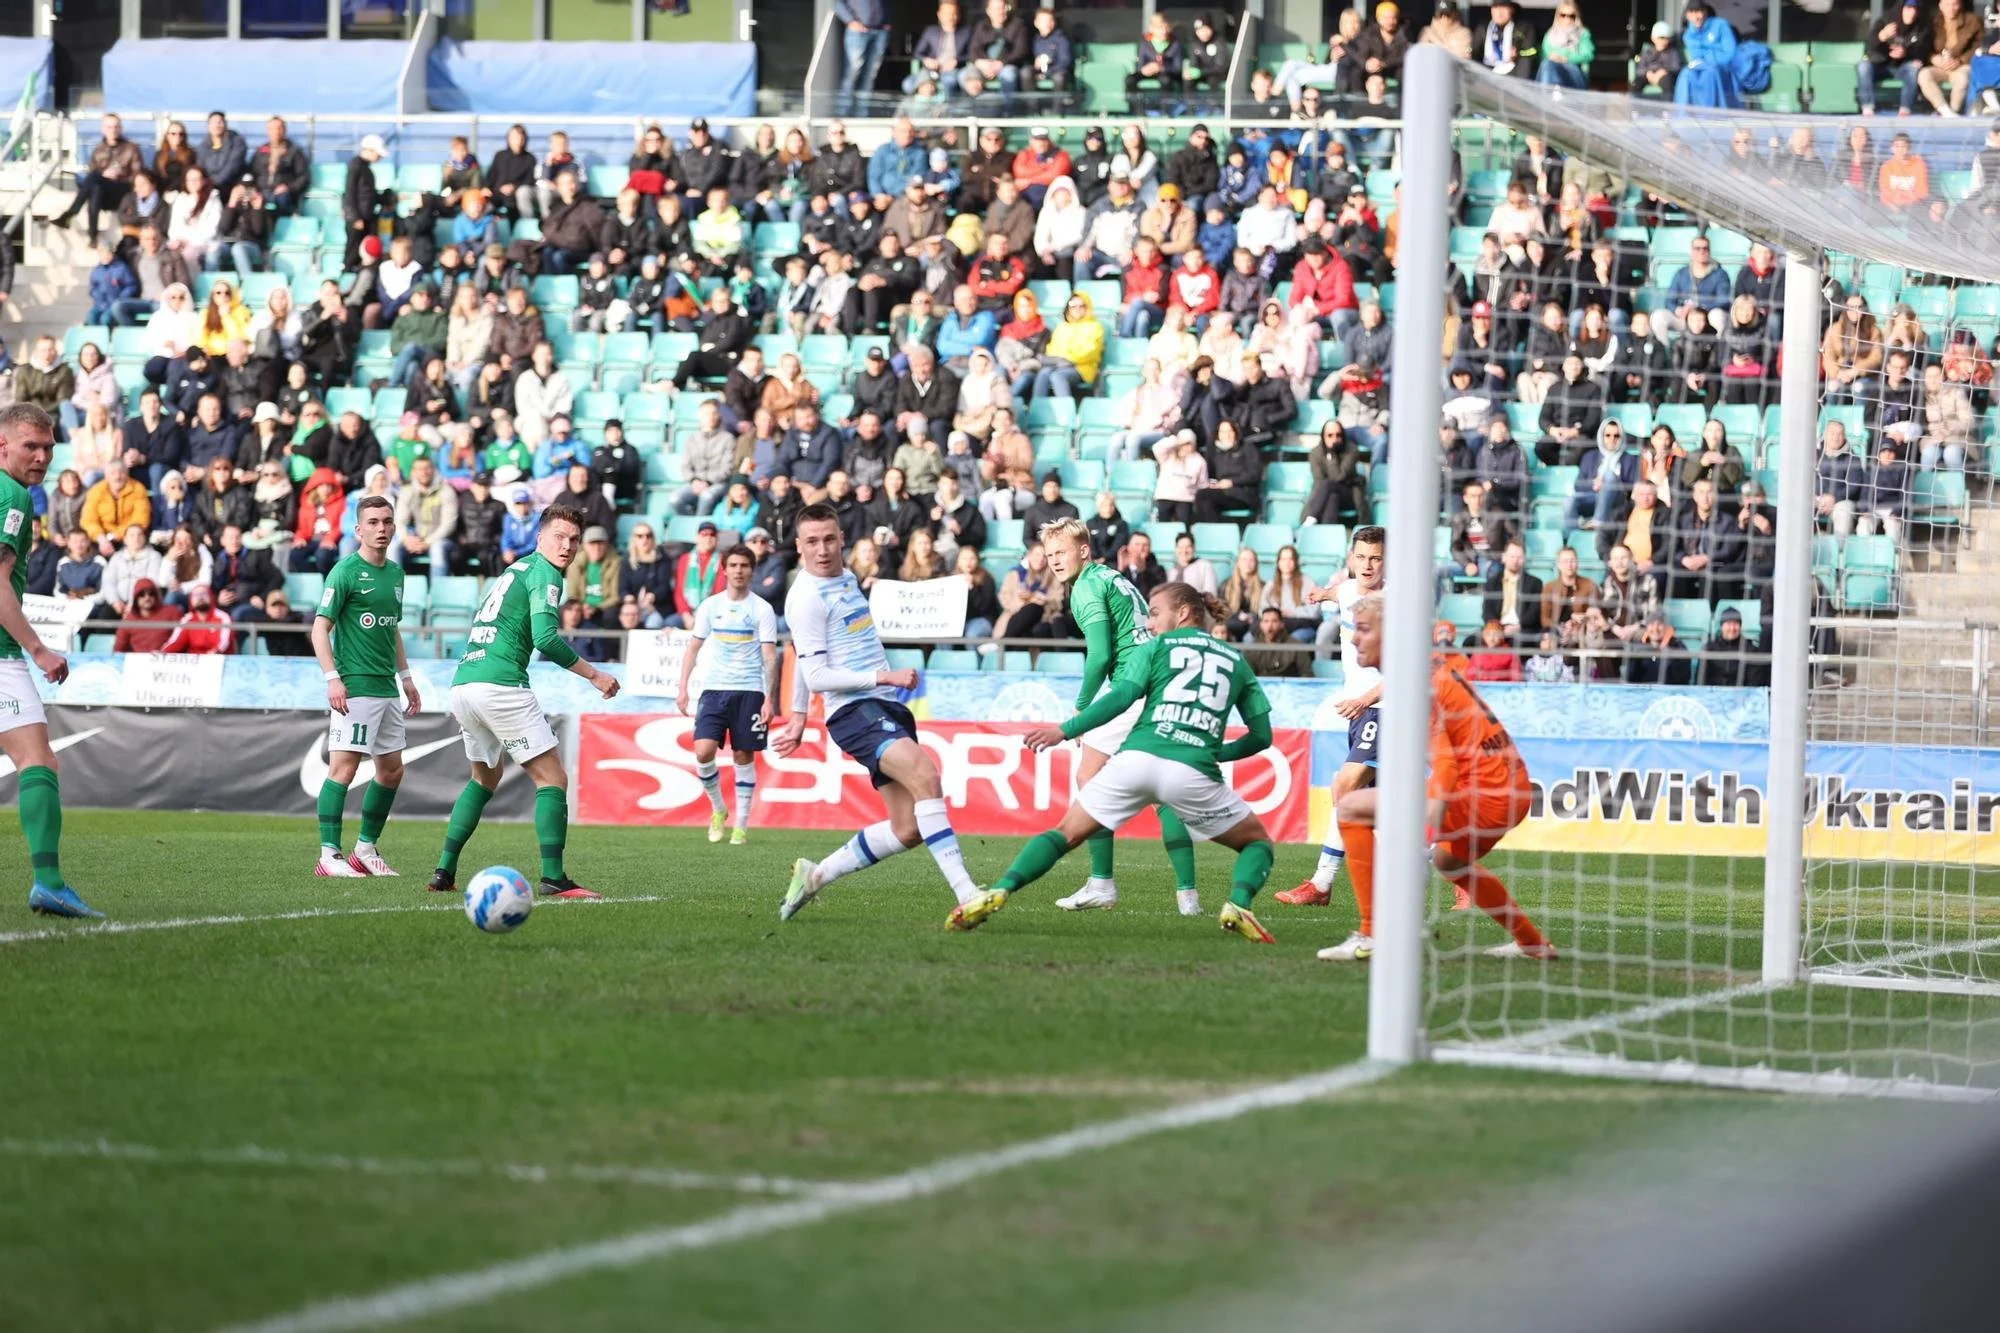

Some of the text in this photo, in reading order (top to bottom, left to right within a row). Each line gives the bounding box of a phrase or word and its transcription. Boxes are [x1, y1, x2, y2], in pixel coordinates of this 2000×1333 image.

[900, 605, 938, 615] With
[881, 620, 950, 630] Ukraine
[1163, 646, 1234, 712] 25
[350, 723, 368, 746] 11
[1361, 721, 1378, 741] 8
